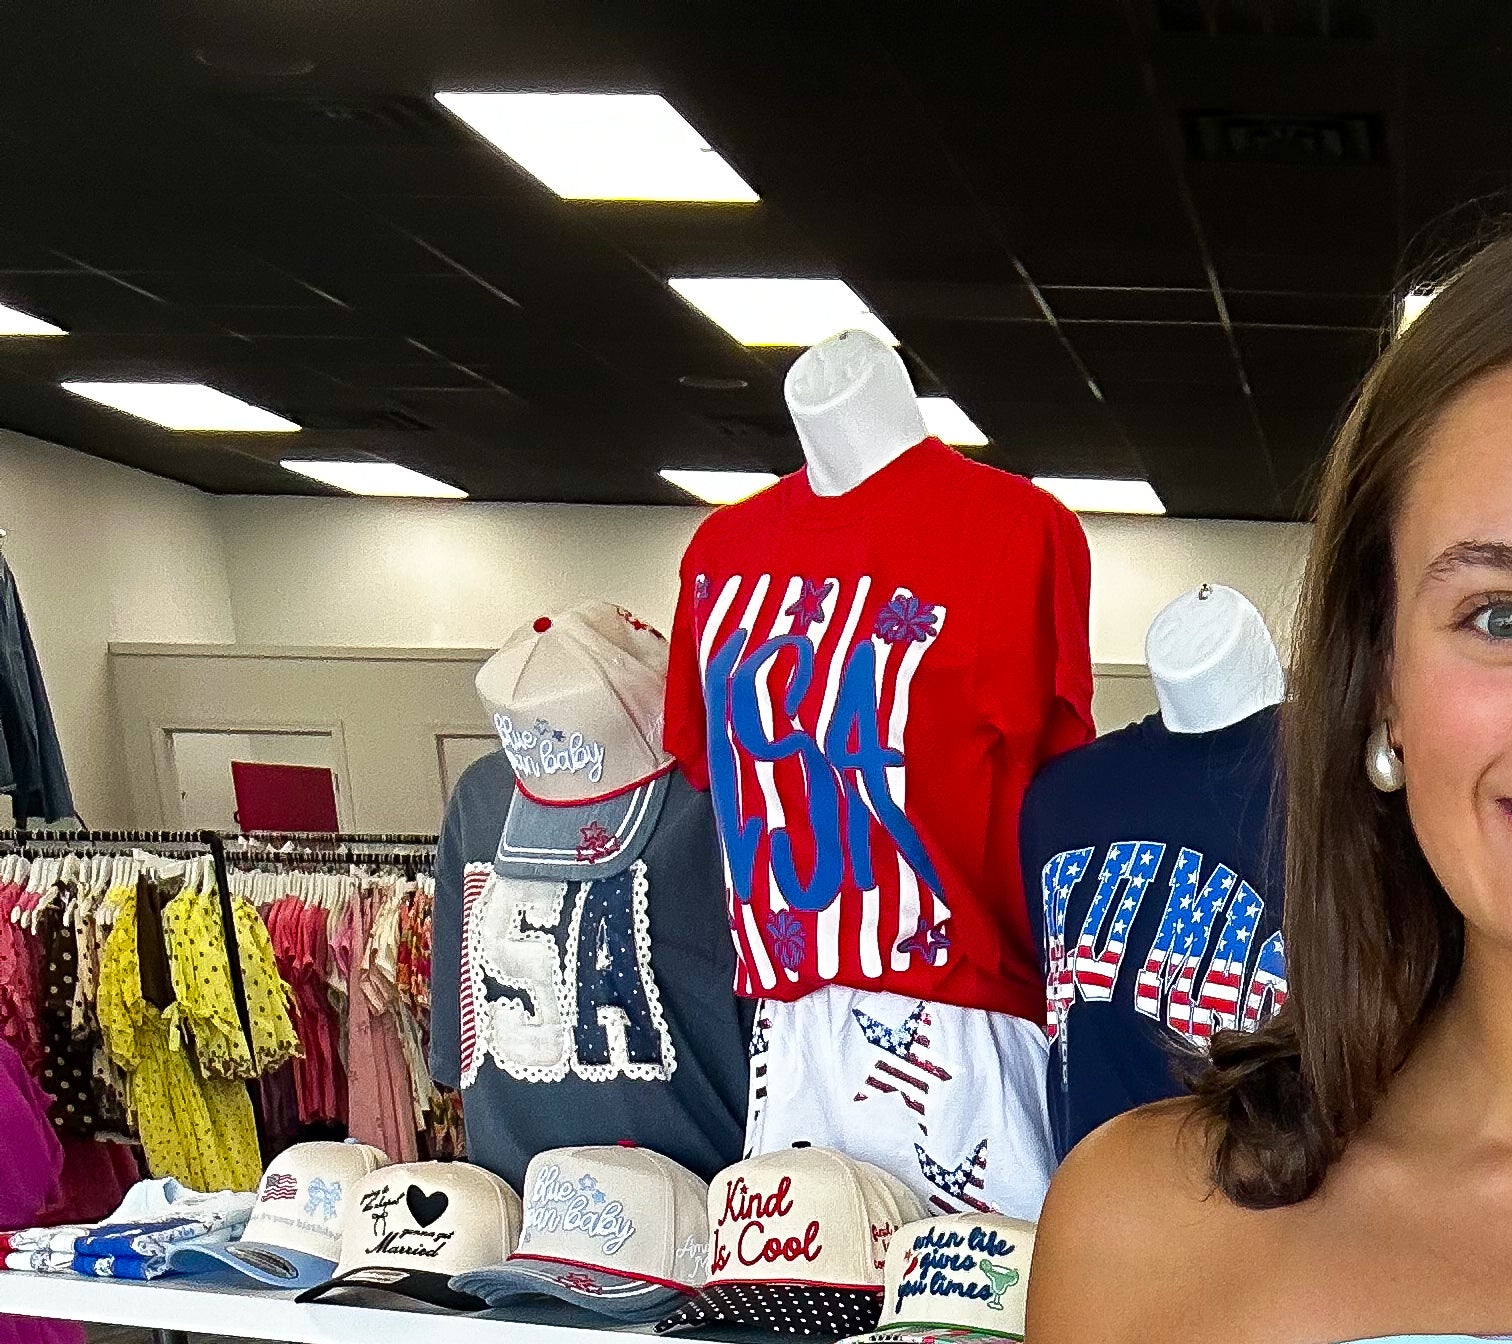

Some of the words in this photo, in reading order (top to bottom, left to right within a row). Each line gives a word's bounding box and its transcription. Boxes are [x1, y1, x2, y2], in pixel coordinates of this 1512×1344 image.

[540, 732, 605, 783] baby
[460, 858, 678, 1089] SA
[718, 1176, 794, 1226] Kind
[365, 1231, 447, 1258] Married
[562, 1194, 636, 1255] baby
[737, 1220, 823, 1266] Cool
[913, 1226, 966, 1252] when
[967, 1226, 1016, 1258] life
[919, 1247, 978, 1280] gives
[929, 1271, 994, 1301] limes
